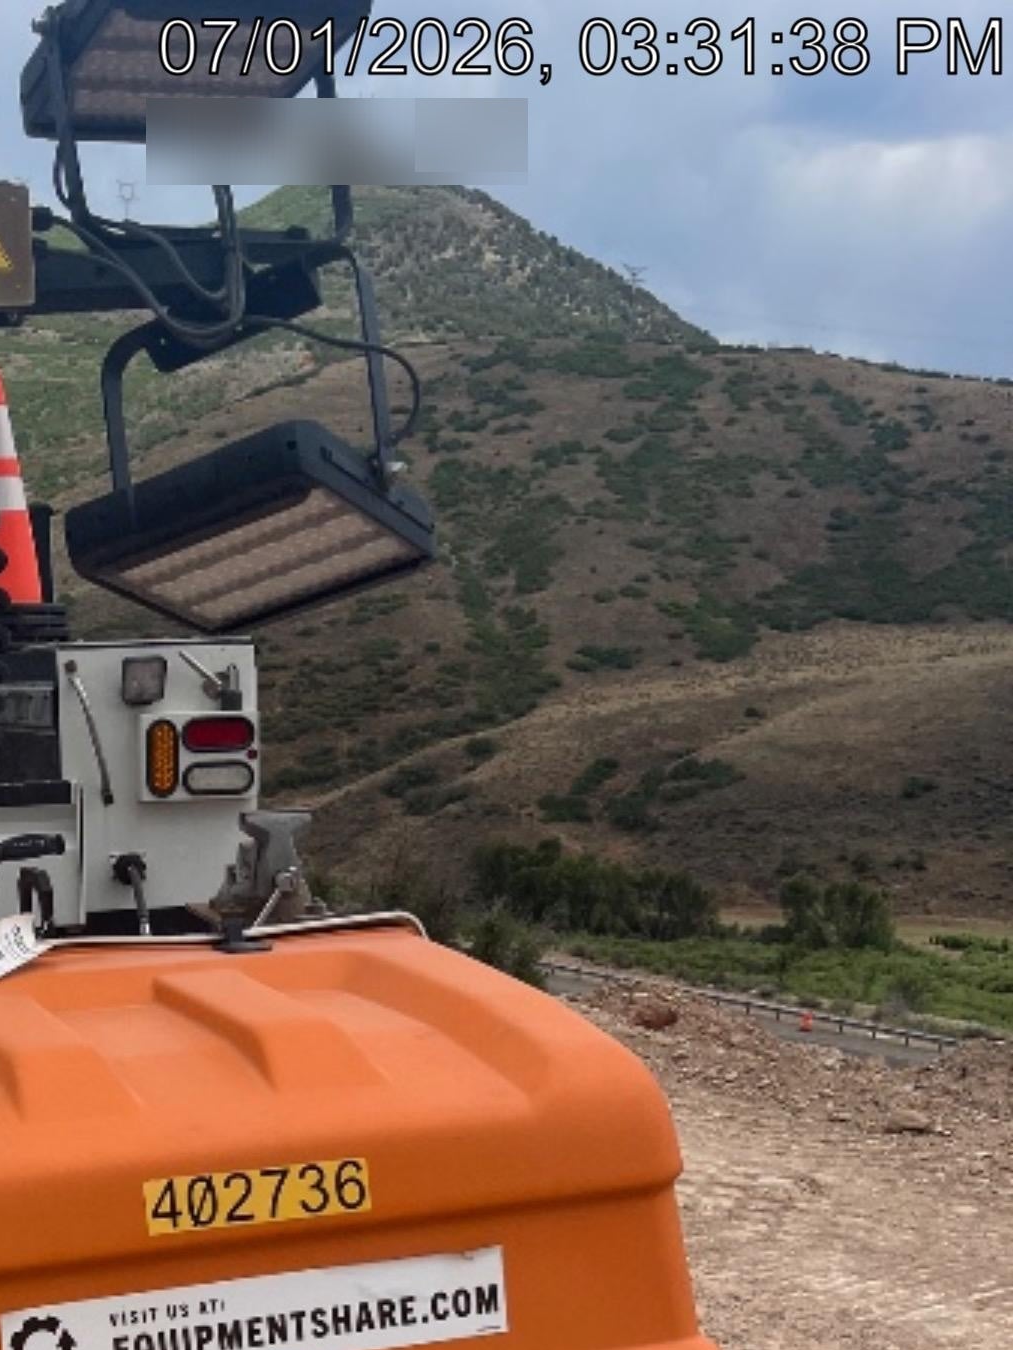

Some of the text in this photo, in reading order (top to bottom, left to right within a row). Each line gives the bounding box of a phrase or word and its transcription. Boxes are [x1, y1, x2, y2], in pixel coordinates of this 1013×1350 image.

[151, 1159, 366, 1228] 402736
[109, 1307, 157, 1327] VISIT
[166, 1302, 189, 1320] US
